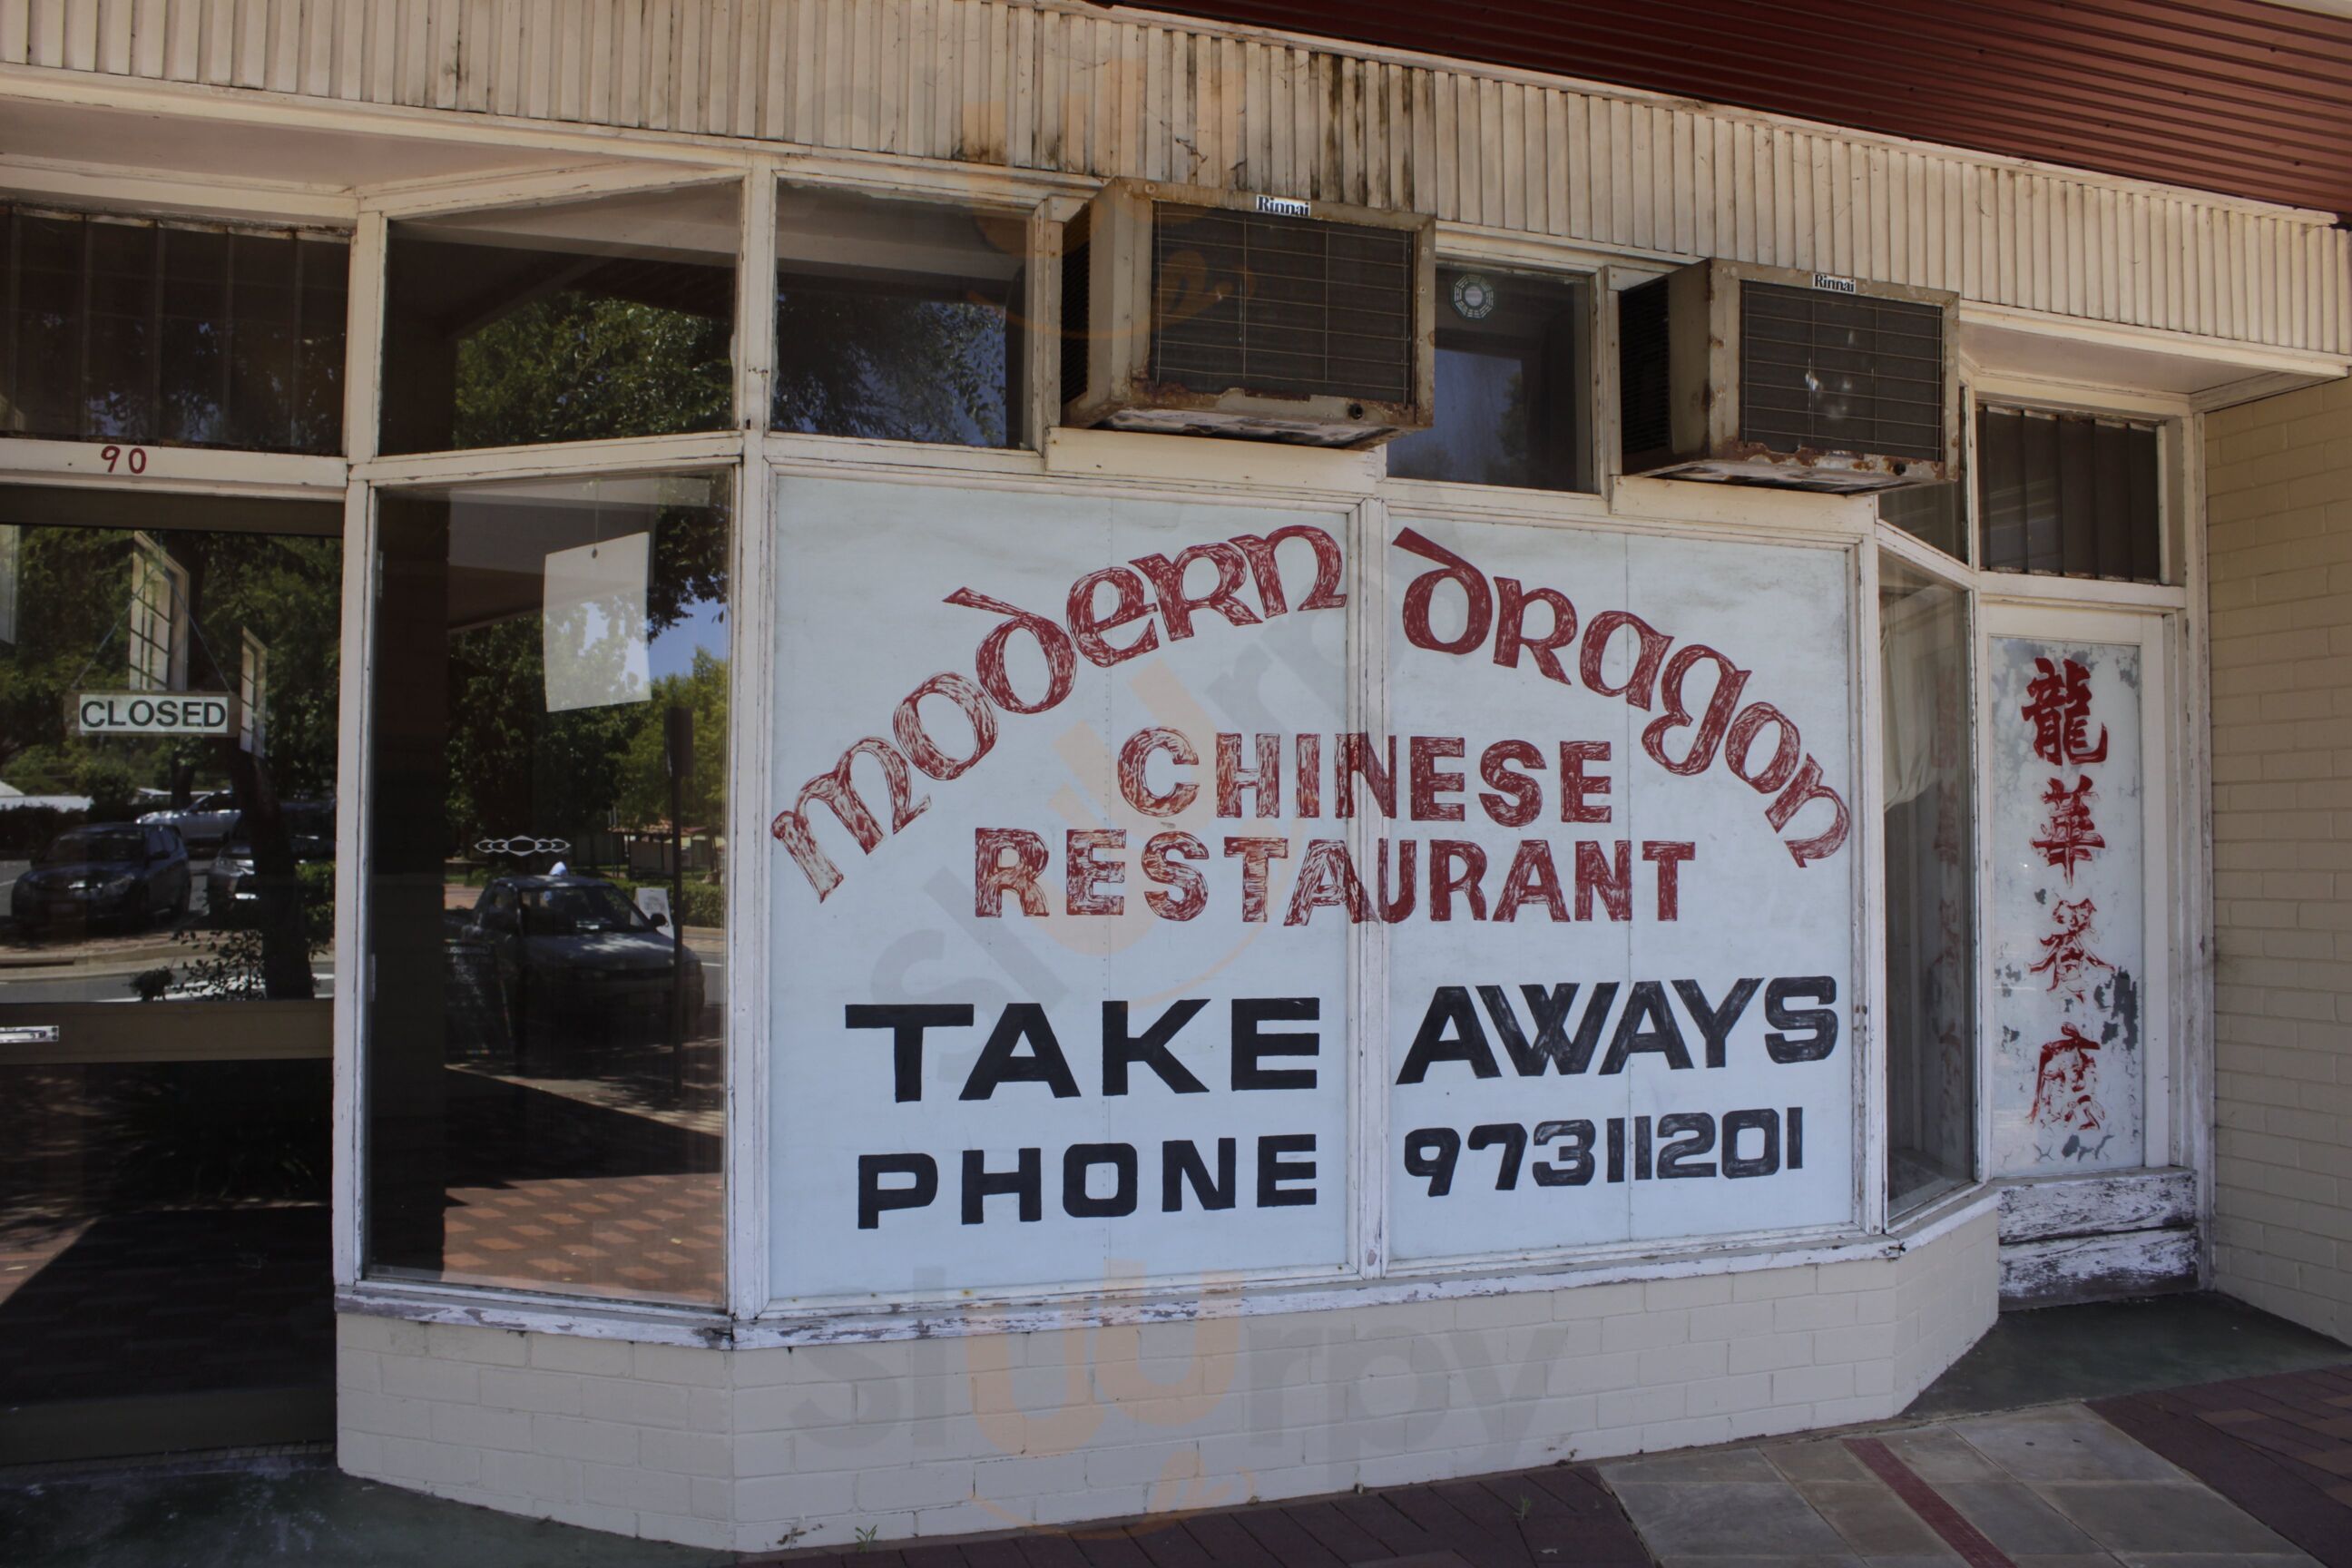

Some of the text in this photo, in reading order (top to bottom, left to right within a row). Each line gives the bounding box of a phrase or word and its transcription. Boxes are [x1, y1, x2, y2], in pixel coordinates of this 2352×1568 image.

[1258, 196, 1309, 217] Rinnai
[1814, 274, 1855, 292] Rinnai
[100, 445, 147, 475] 90
[80, 700, 227, 728] CLOSED
[1117, 727, 1612, 828] CHINESE
[975, 827, 1696, 926] RESTAURANT
[845, 975, 1839, 1102] TAKE AWAYS
[858, 1106, 1803, 1230] PHONE 97311201
